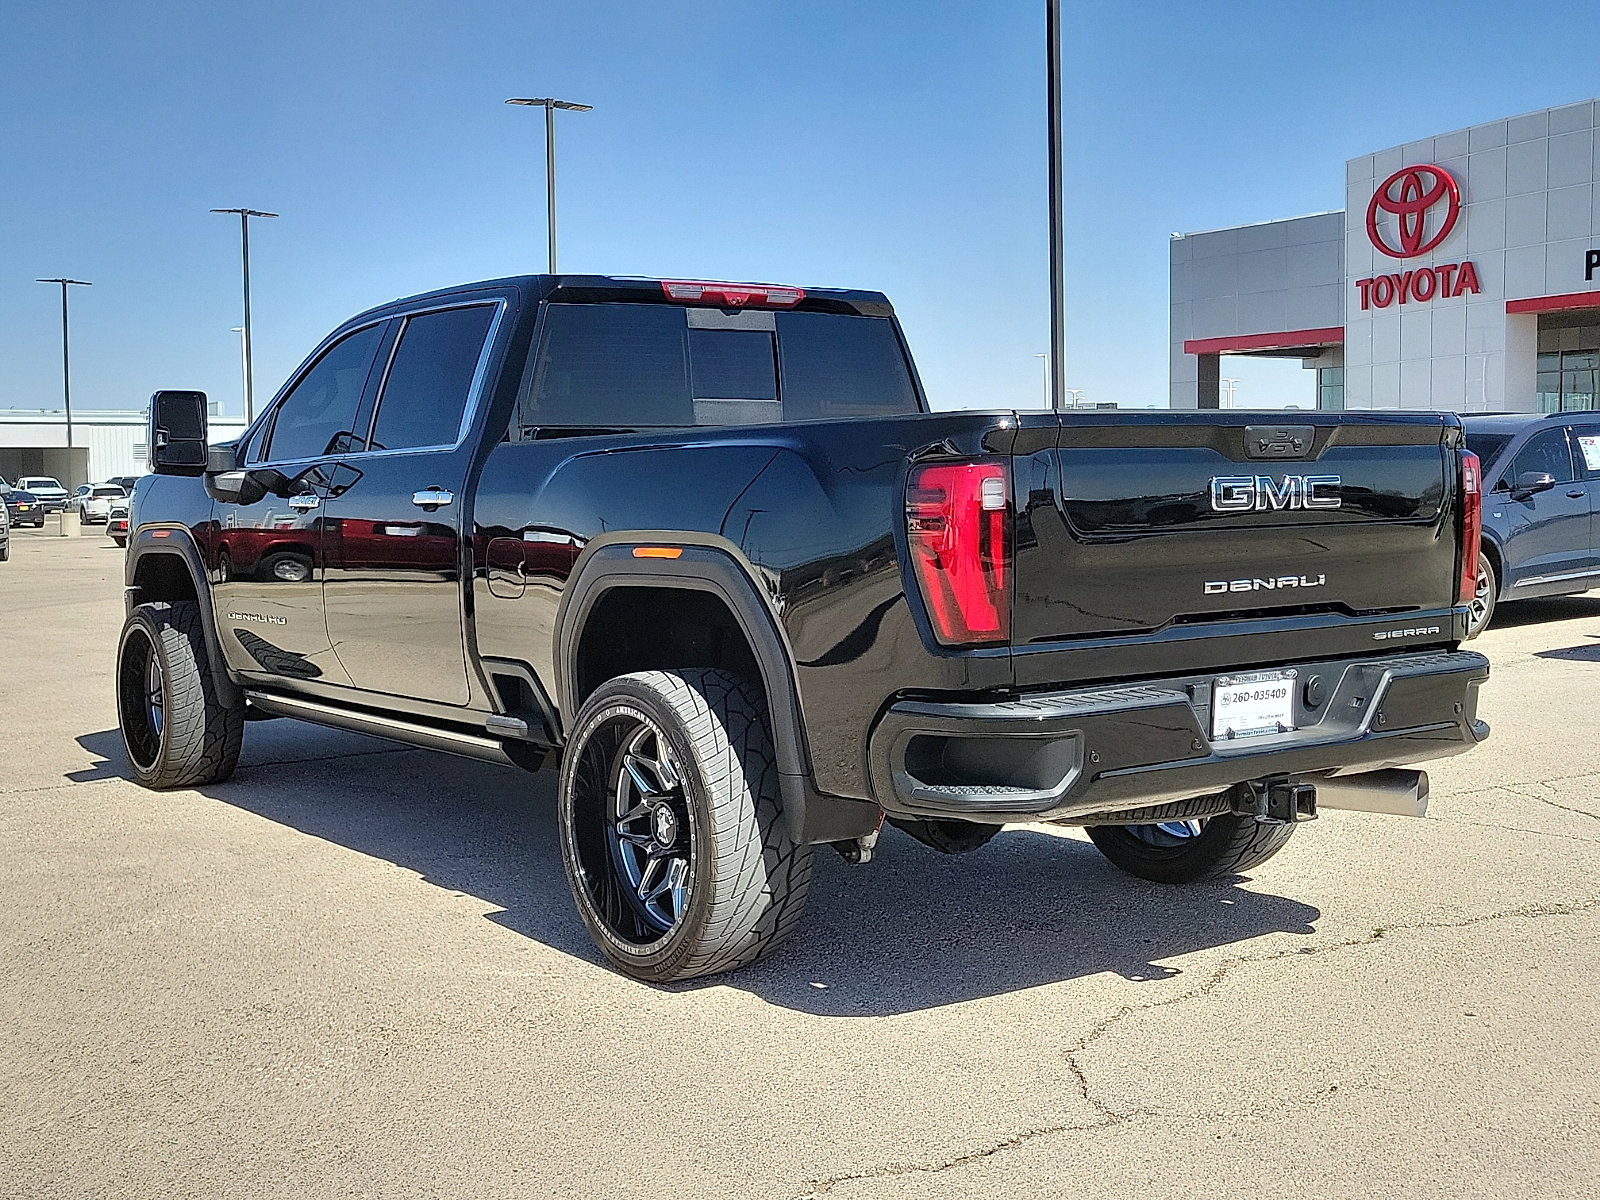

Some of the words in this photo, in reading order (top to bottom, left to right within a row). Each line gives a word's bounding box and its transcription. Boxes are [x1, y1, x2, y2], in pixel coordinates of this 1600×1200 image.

[1355, 261, 1481, 311] TOYOTA
[1210, 474, 1341, 511] GMC
[1203, 574, 1326, 595] DENALI
[1373, 626, 1440, 641] SIERRA
[1232, 688, 1287, 703] 26D-035409
[616, 706, 645, 723] AMERICAN
